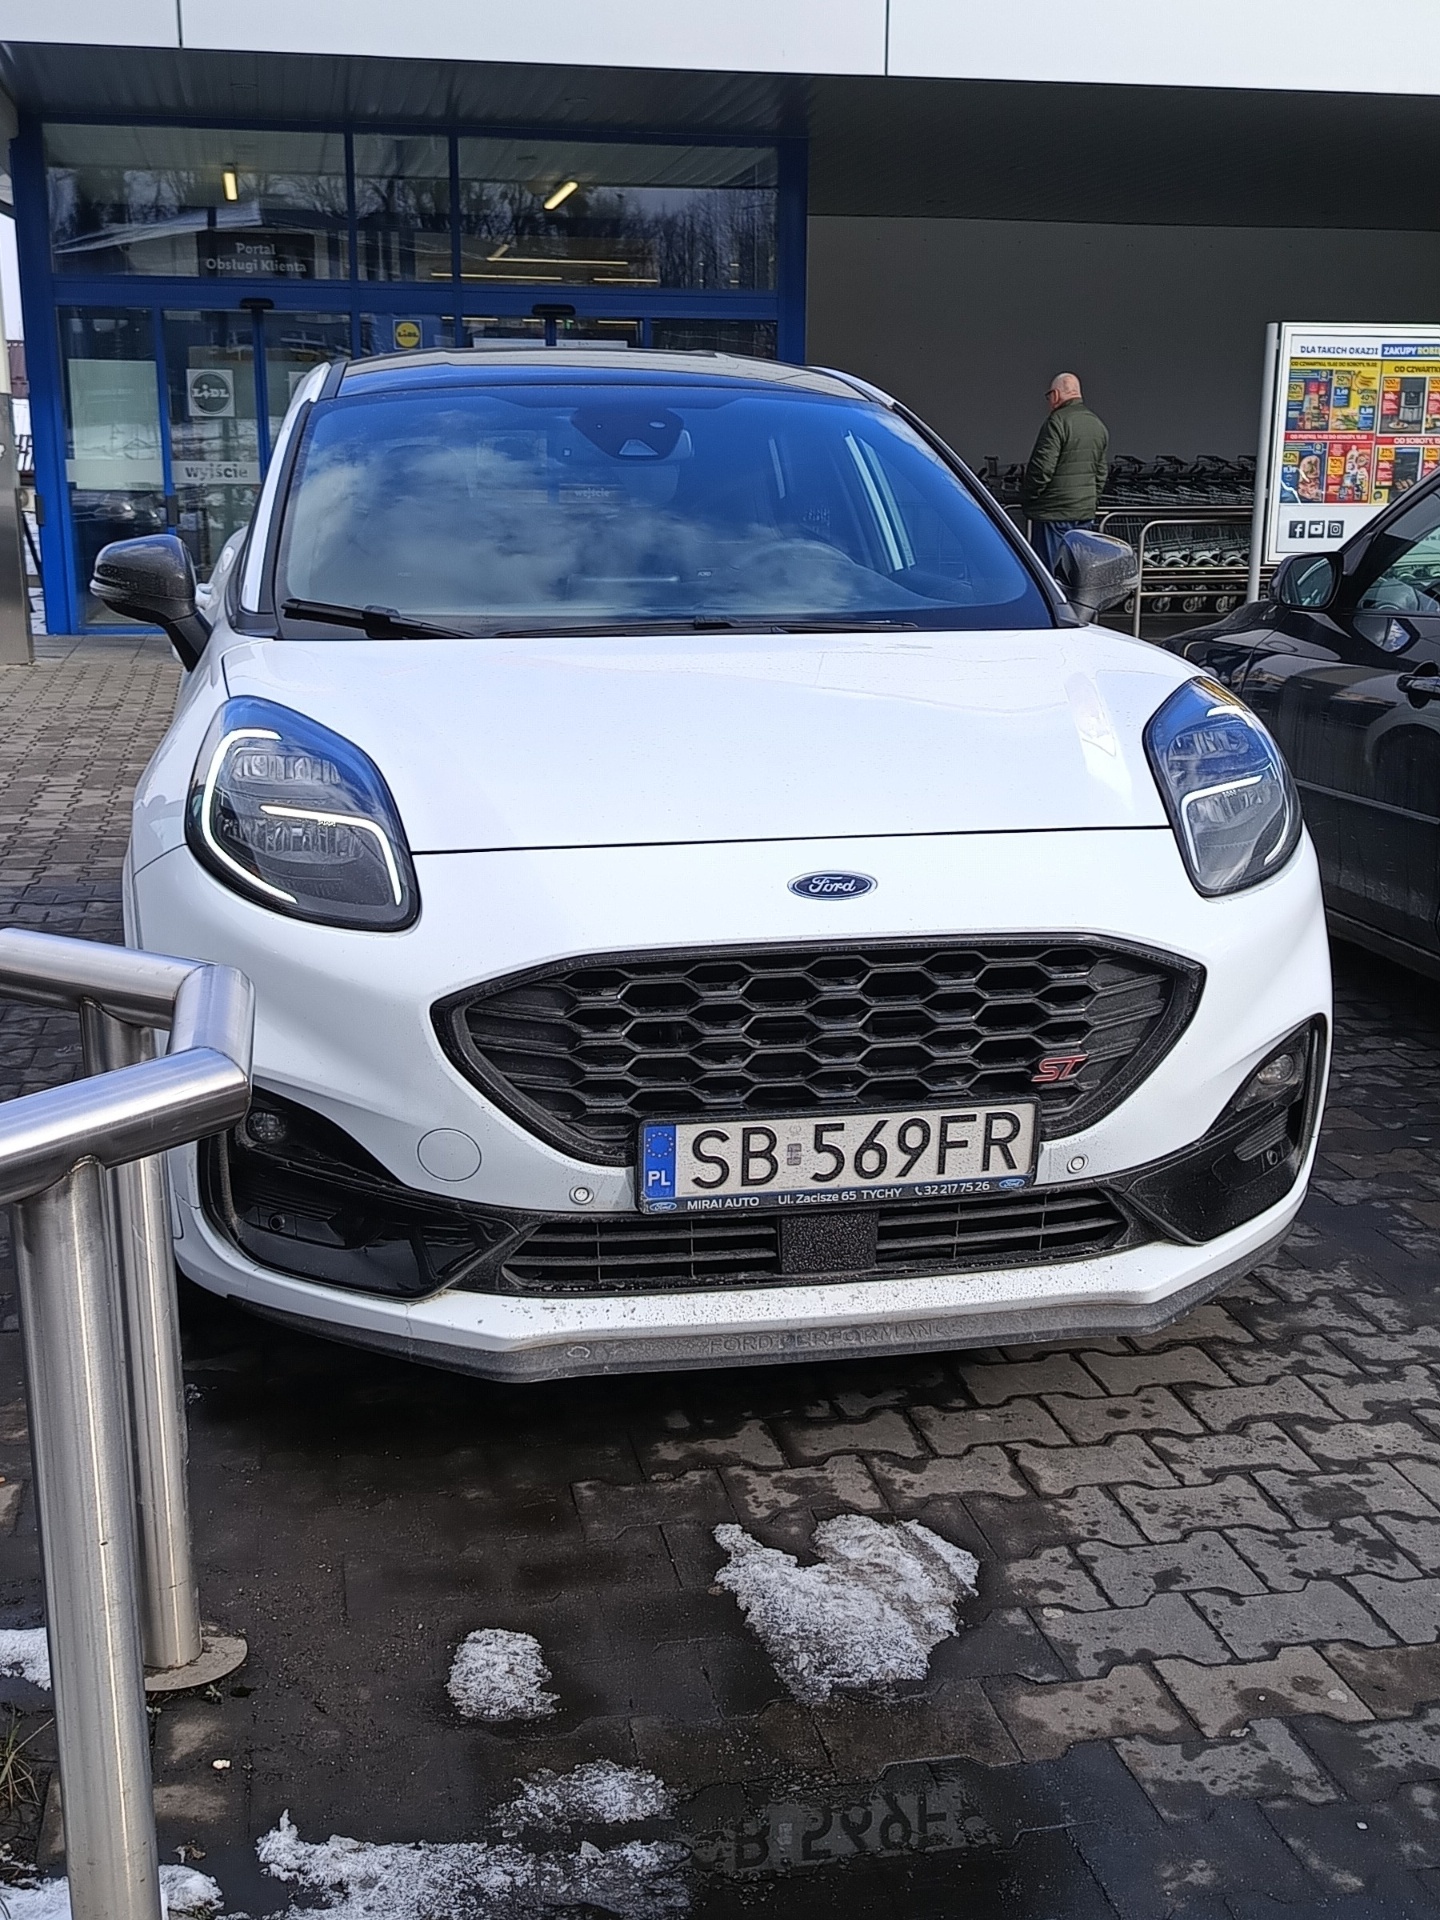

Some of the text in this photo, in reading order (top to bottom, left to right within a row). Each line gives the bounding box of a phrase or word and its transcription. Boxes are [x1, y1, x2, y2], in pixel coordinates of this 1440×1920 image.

[235, 242, 276, 255] Portal
[261, 259, 307, 272] Klienta
[1300, 345, 1316, 354] DLA
[1318, 345, 1347, 355] TAKICH
[1383, 346, 1417, 355] ZAKUPY
[191, 384, 230, 399] LIDL
[185, 463, 248, 481] wyjście
[808, 876, 857, 893] Ford
[1031, 1054, 1089, 1082] ST
[692, 1111, 1021, 1189] SB 569FR
[647, 1170, 671, 1187] PL
[687, 1200, 723, 1211] MIRAI
[725, 1197, 760, 1208] AUTO
[795, 1193, 839, 1204] Zacisze
[841, 1191, 857, 1201] 65
[861, 1187, 902, 1200] TYCHY
[923, 1186, 938, 1195] 32
[940, 1184, 958, 1194] 217
[960, 1182, 973, 1192] 75
[975, 1181, 990, 1191] 26
[708, 1335, 773, 1354] FORD
